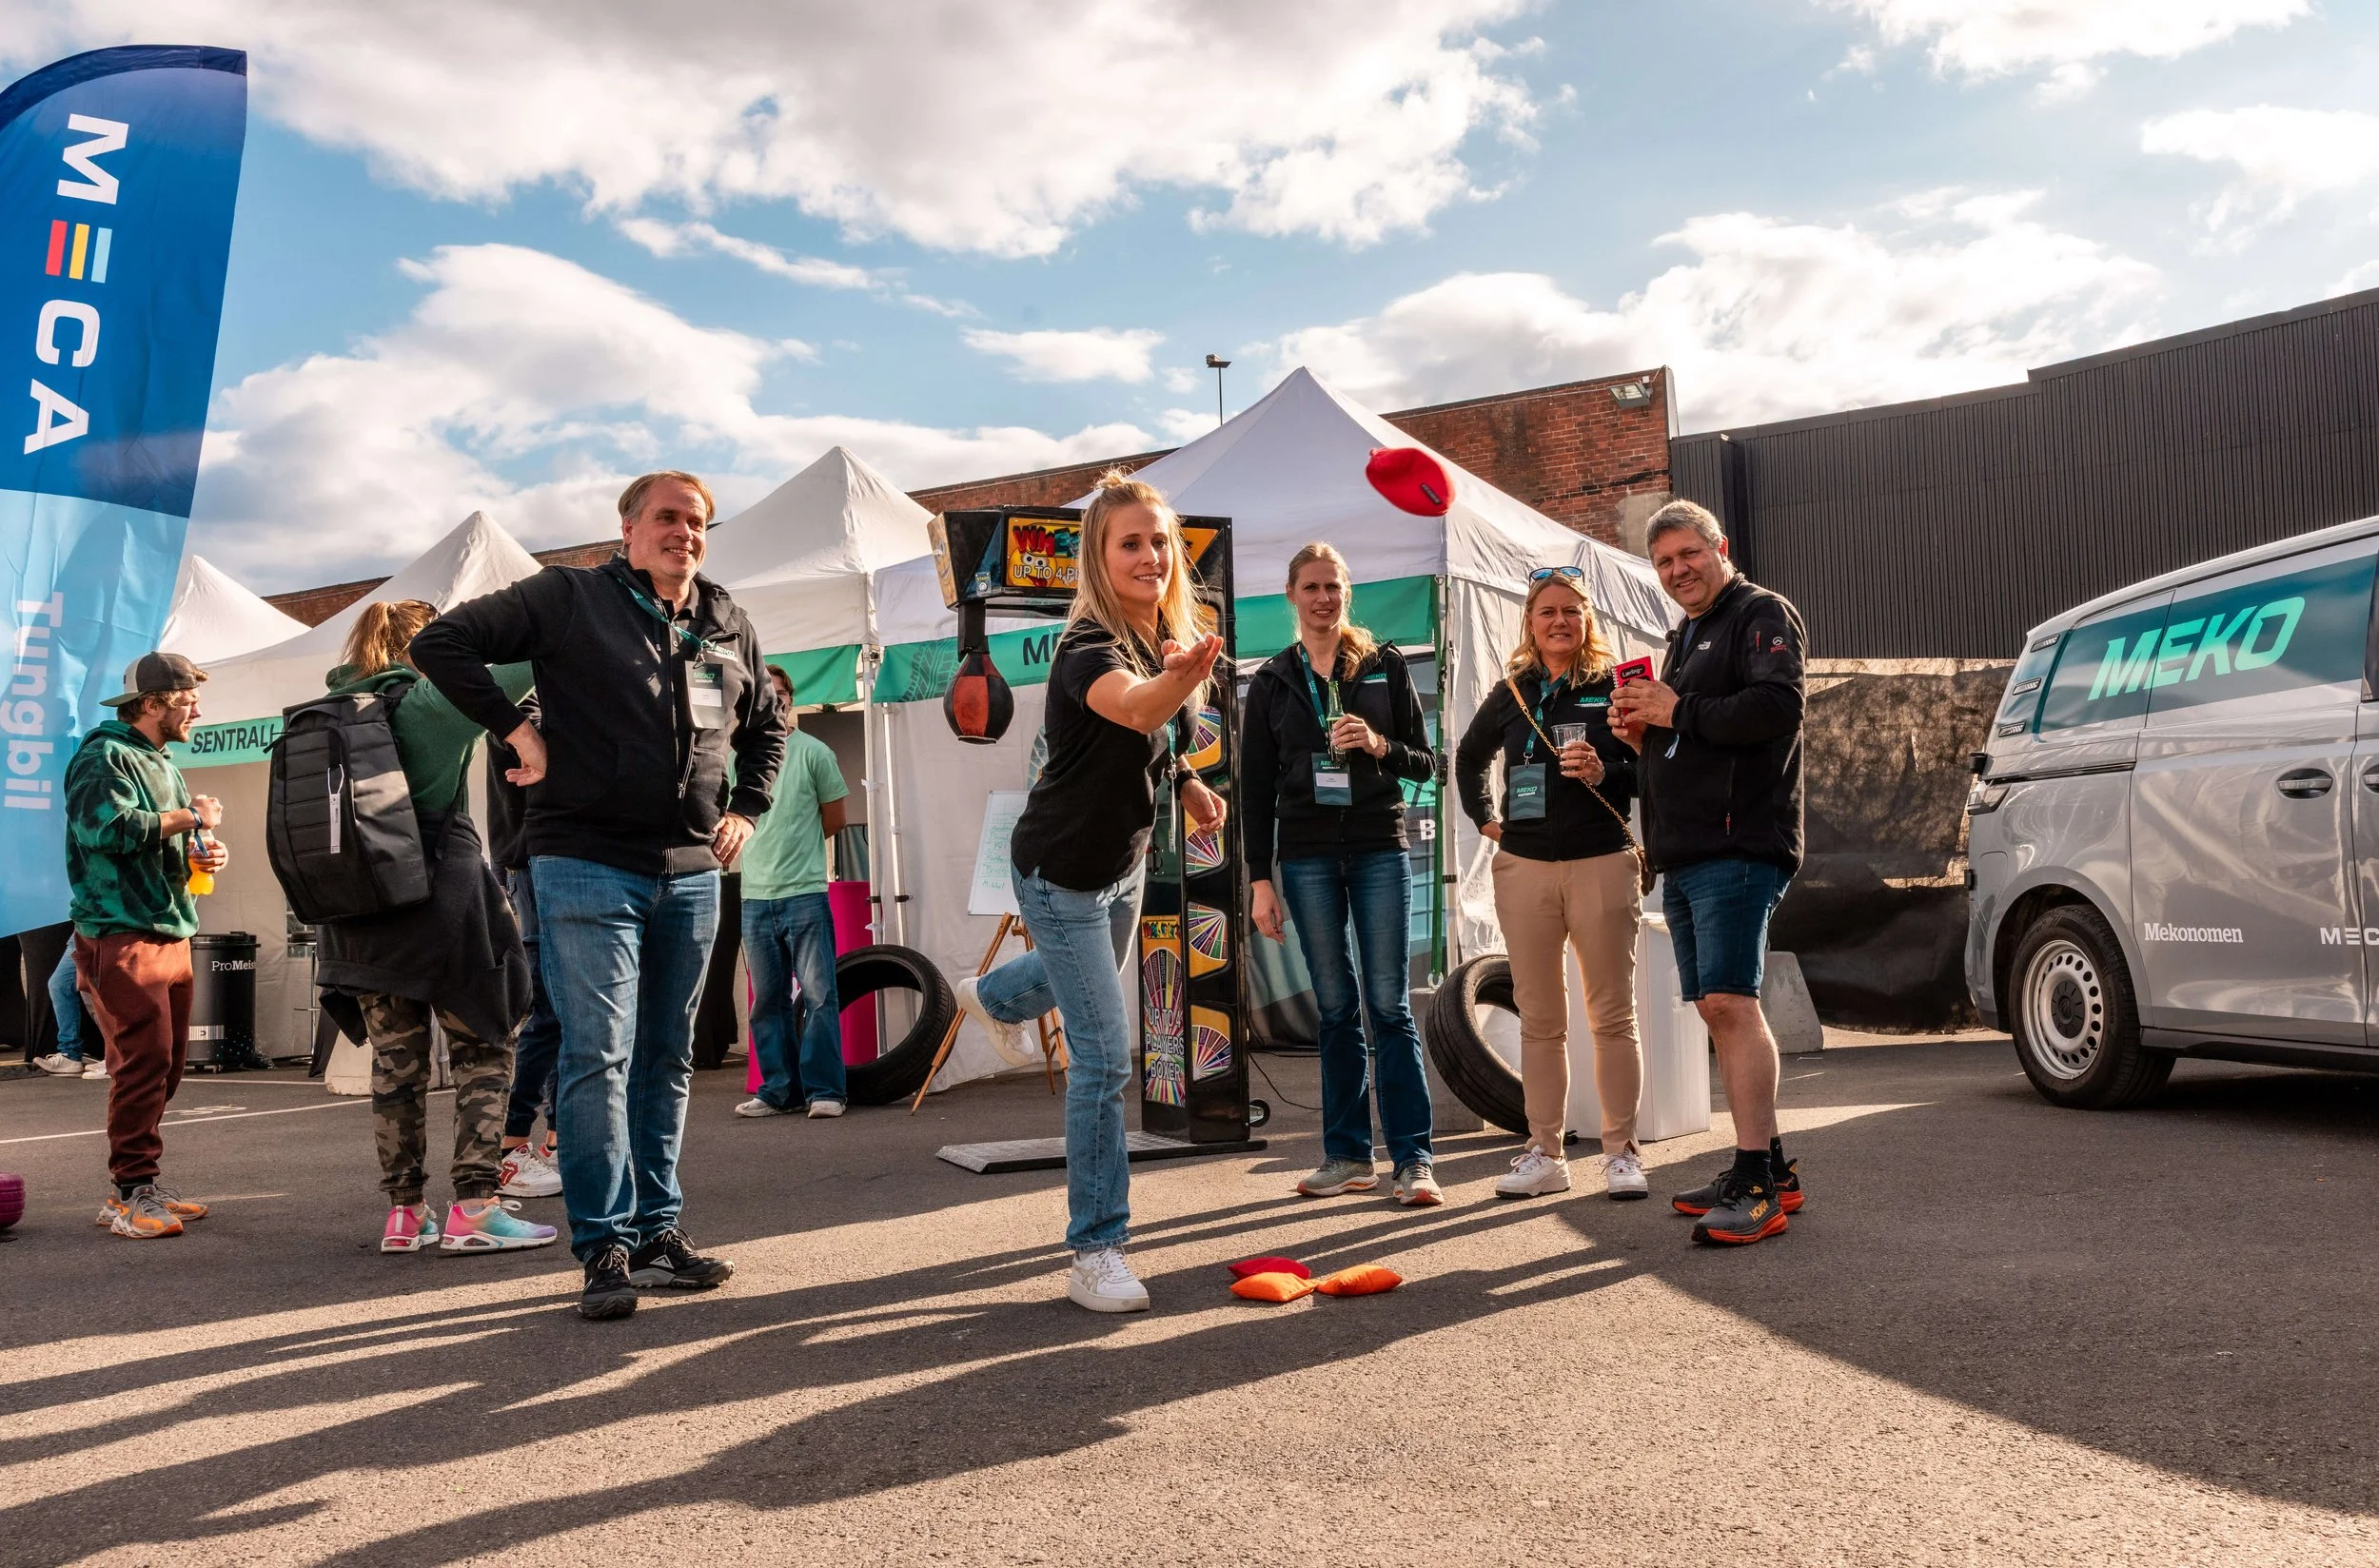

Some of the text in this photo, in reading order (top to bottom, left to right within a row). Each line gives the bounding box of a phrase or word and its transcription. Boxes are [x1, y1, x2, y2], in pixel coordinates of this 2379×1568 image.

[24, 113, 128, 455] MECA
[1013, 565, 1032, 578] UP
[1035, 566, 1052, 579] TO
[1055, 567, 1063, 579] 4
[2088, 596, 2306, 701] MEKO
[0, 592, 64, 810] Tungbil
[2144, 923, 2244, 943] Mekonomen
[2320, 927, 2379, 946] MEC
[1149, 1009, 1160, 1026] UP
[1162, 1009, 1173, 1028] TO
[1145, 1033, 1185, 1056] PLAYERS
[1150, 1060, 1181, 1082] BOXER
[1749, 1199, 1769, 1223] HOKA
